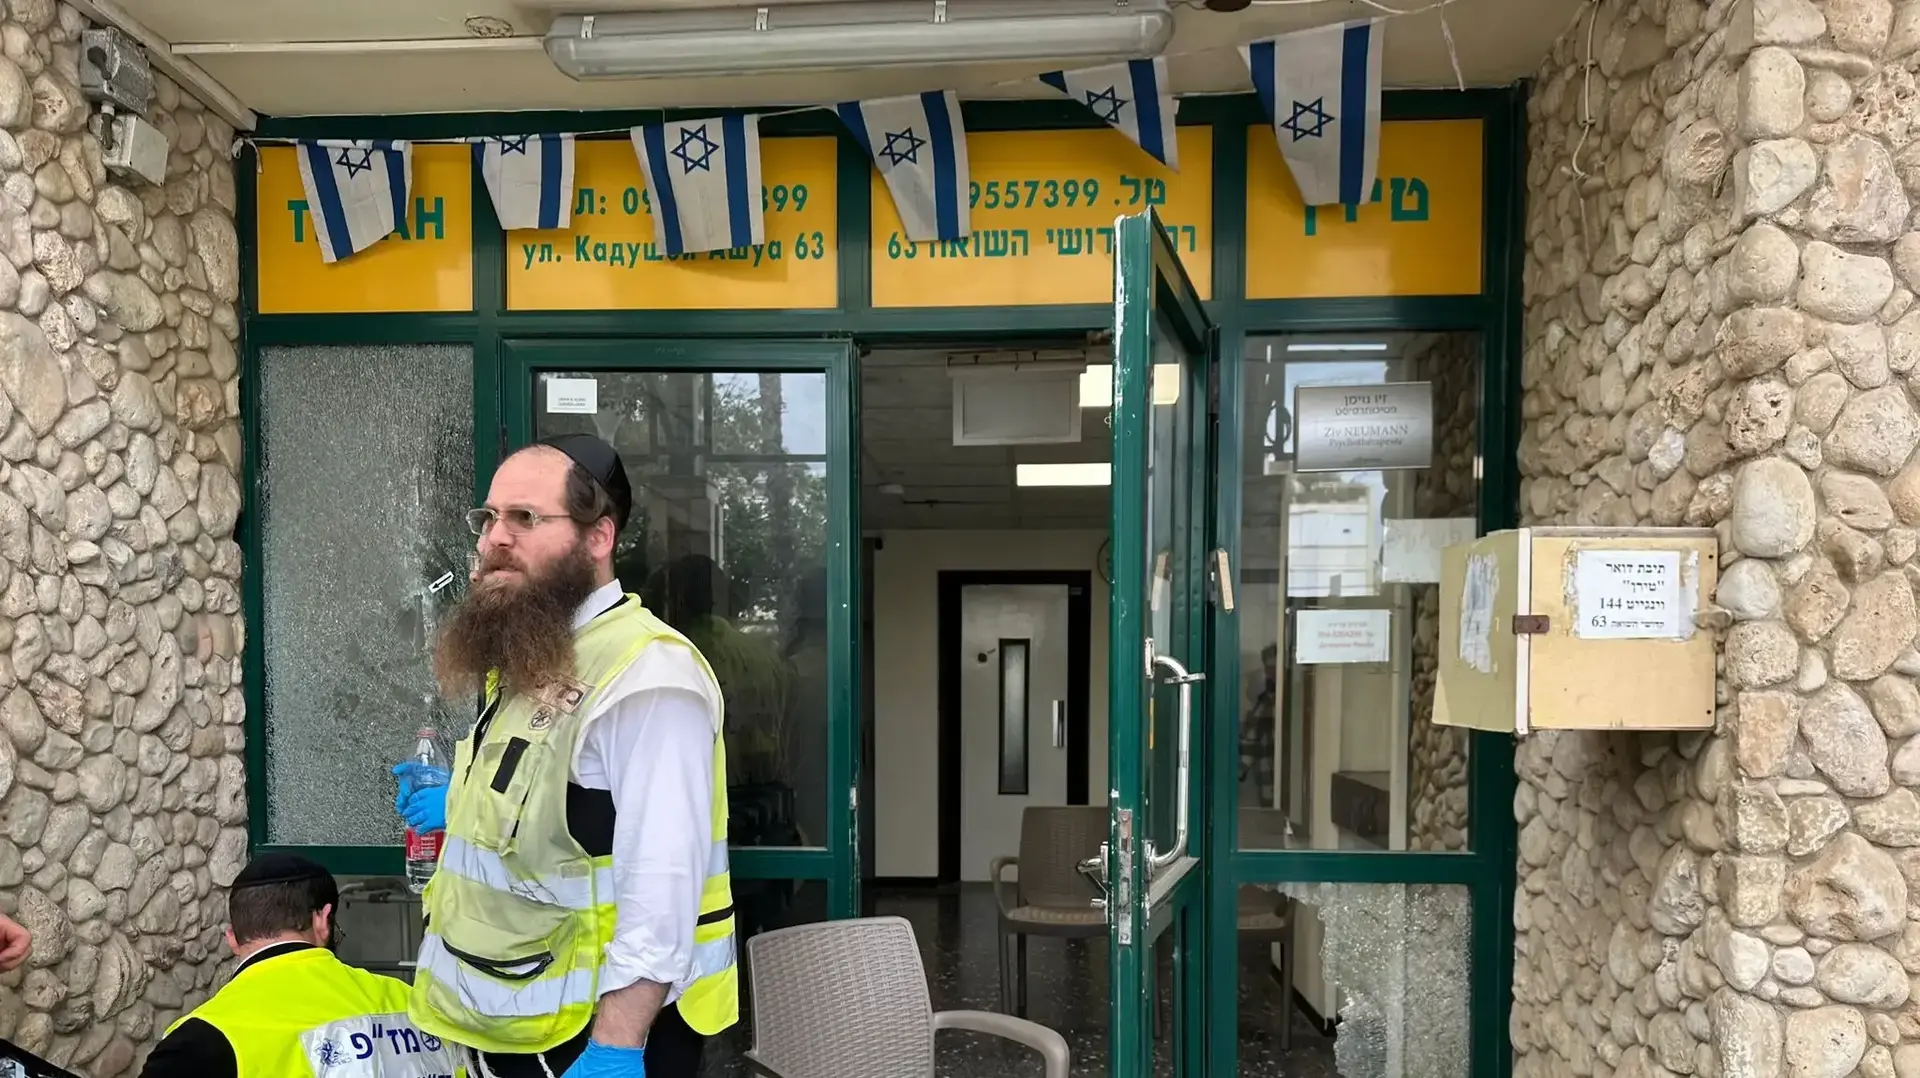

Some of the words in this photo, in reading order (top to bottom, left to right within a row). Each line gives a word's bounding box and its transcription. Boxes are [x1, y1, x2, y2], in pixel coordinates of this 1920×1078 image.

[1114, 174, 1166, 206] טל.
[522, 243, 562, 270] ул.
[794, 231, 824, 260] 63
[1324, 426, 1342, 438] Ziv
[1344, 423, 1409, 437] NEUMANN
[1606, 563, 1633, 573] דואר
[1637, 564, 1665, 574] תיבת
[1600, 597, 1622, 610] 144
[1591, 615, 1607, 628] 63
